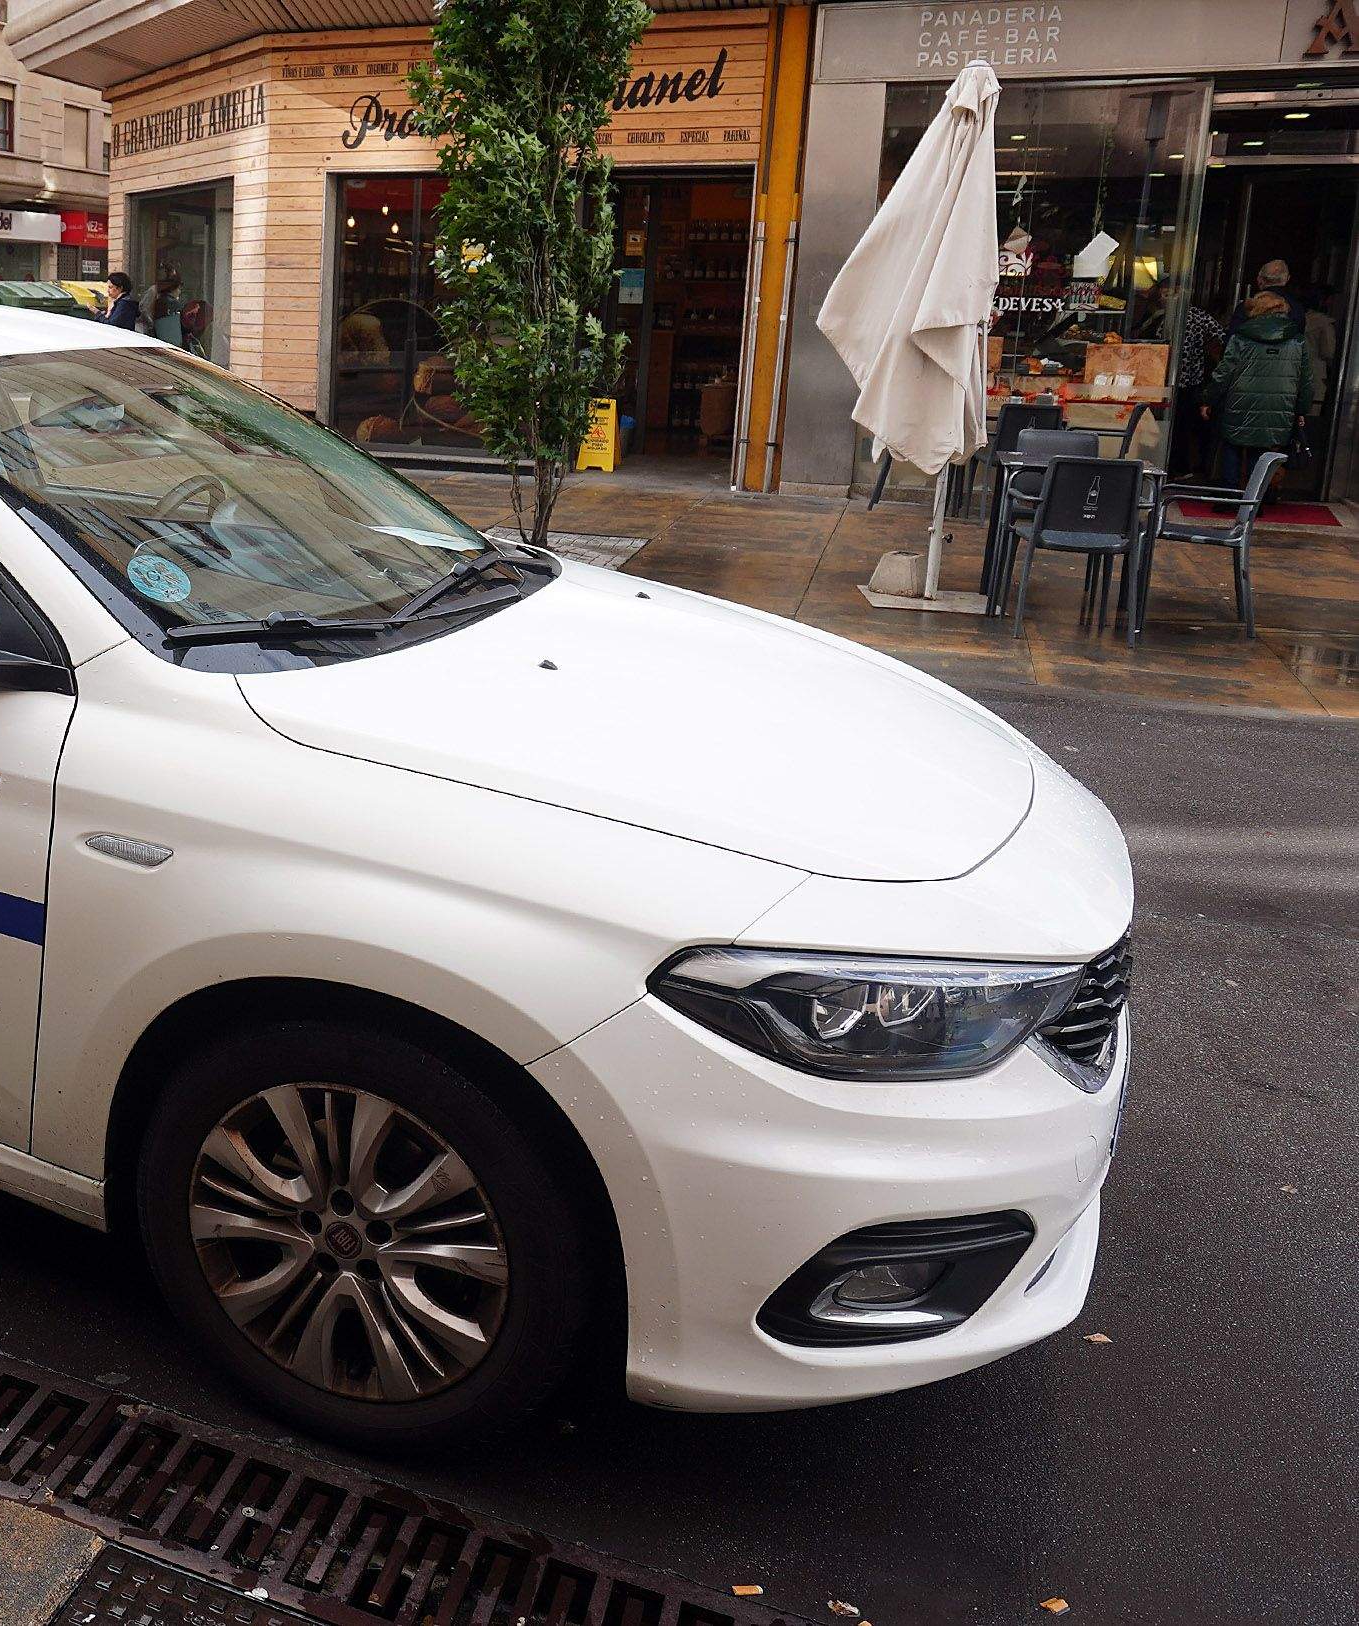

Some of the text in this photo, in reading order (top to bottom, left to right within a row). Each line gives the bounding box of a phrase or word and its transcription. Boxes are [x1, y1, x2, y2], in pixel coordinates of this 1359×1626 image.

[920, 2, 1063, 27] PANADERÍA
[918, 25, 1060, 47] CAFÉ-BAR
[916, 44, 1058, 68] PASTELERÍA
[124, 105, 183, 155] GRANEIRO
[187, 99, 205, 141] DE
[208, 83, 266, 136] AMELIA
